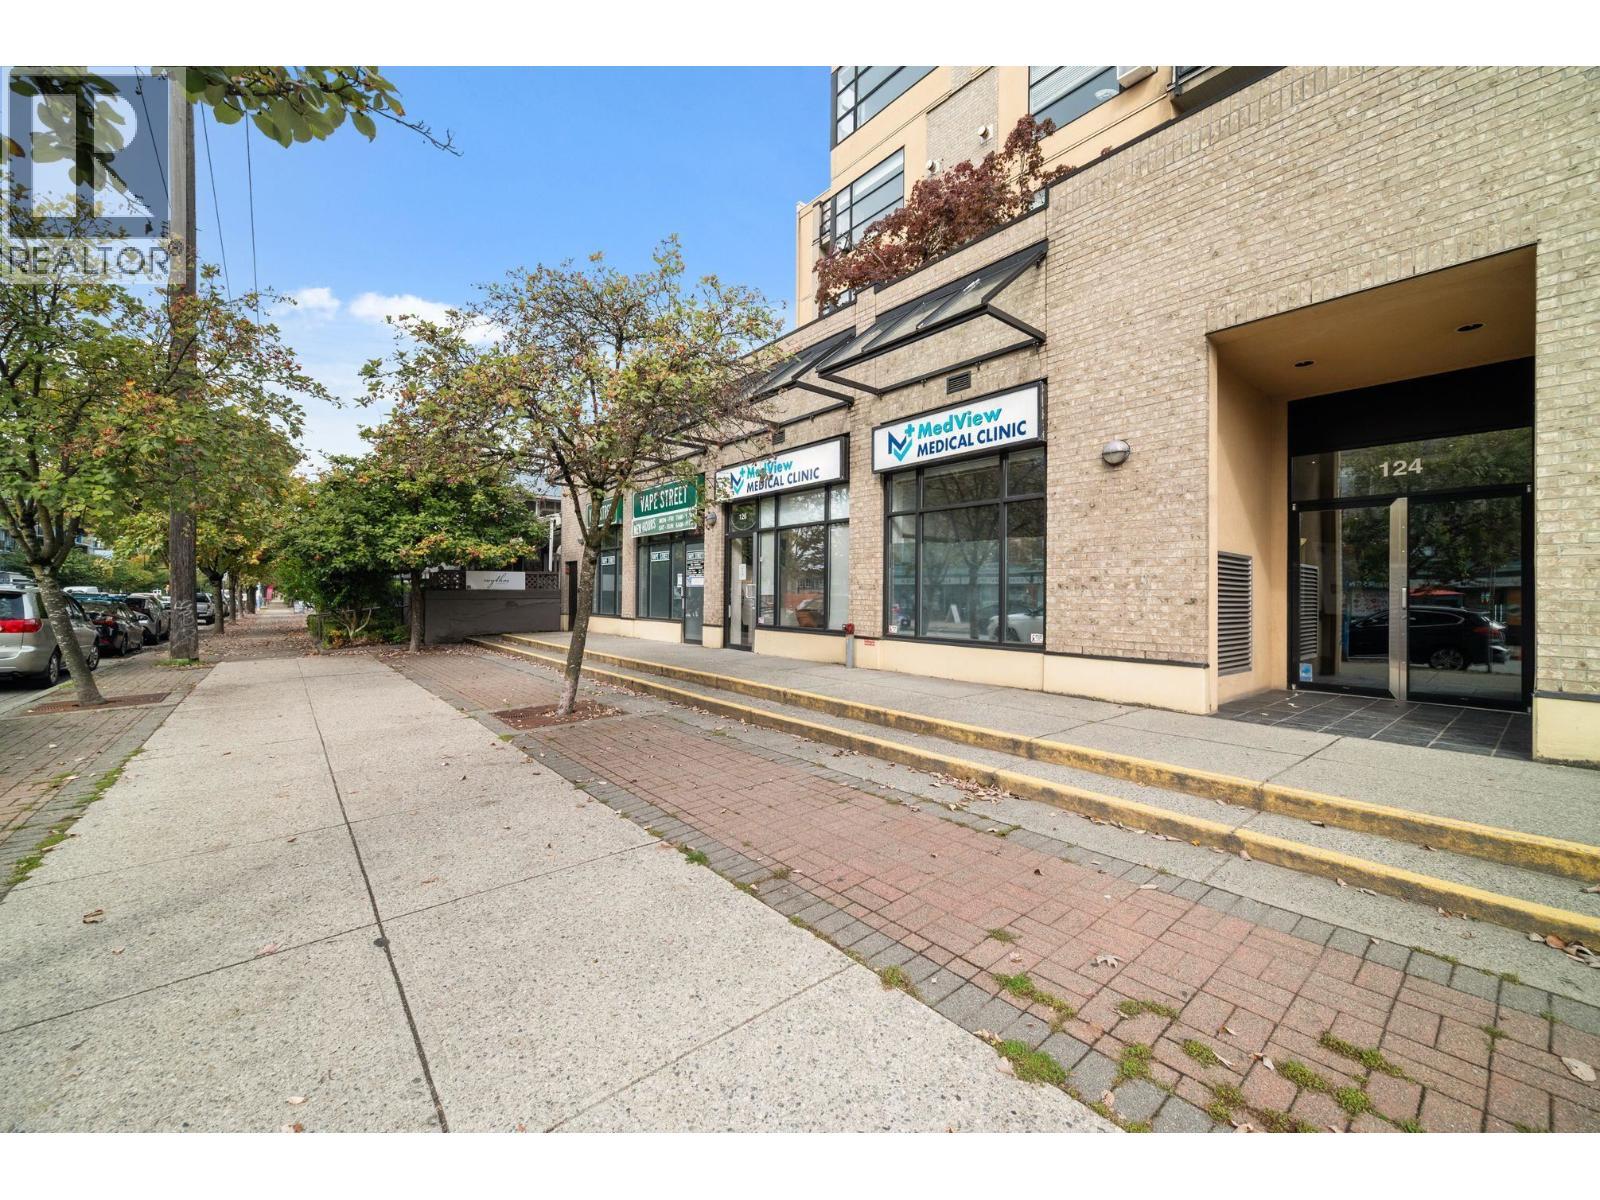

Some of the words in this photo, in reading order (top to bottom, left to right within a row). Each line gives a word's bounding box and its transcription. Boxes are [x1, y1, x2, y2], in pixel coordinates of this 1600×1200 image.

[917, 408, 1002, 440] MedView
[917, 435, 974, 458] MEDICAL
[976, 420, 1027, 443] CLINIC
[746, 474, 784, 493] MEDICAL
[787, 467, 820, 485] CLINIC
[1379, 457, 1423, 478] 124
[640, 492, 658, 512] VAPE
[660, 485, 688, 509] STREET
